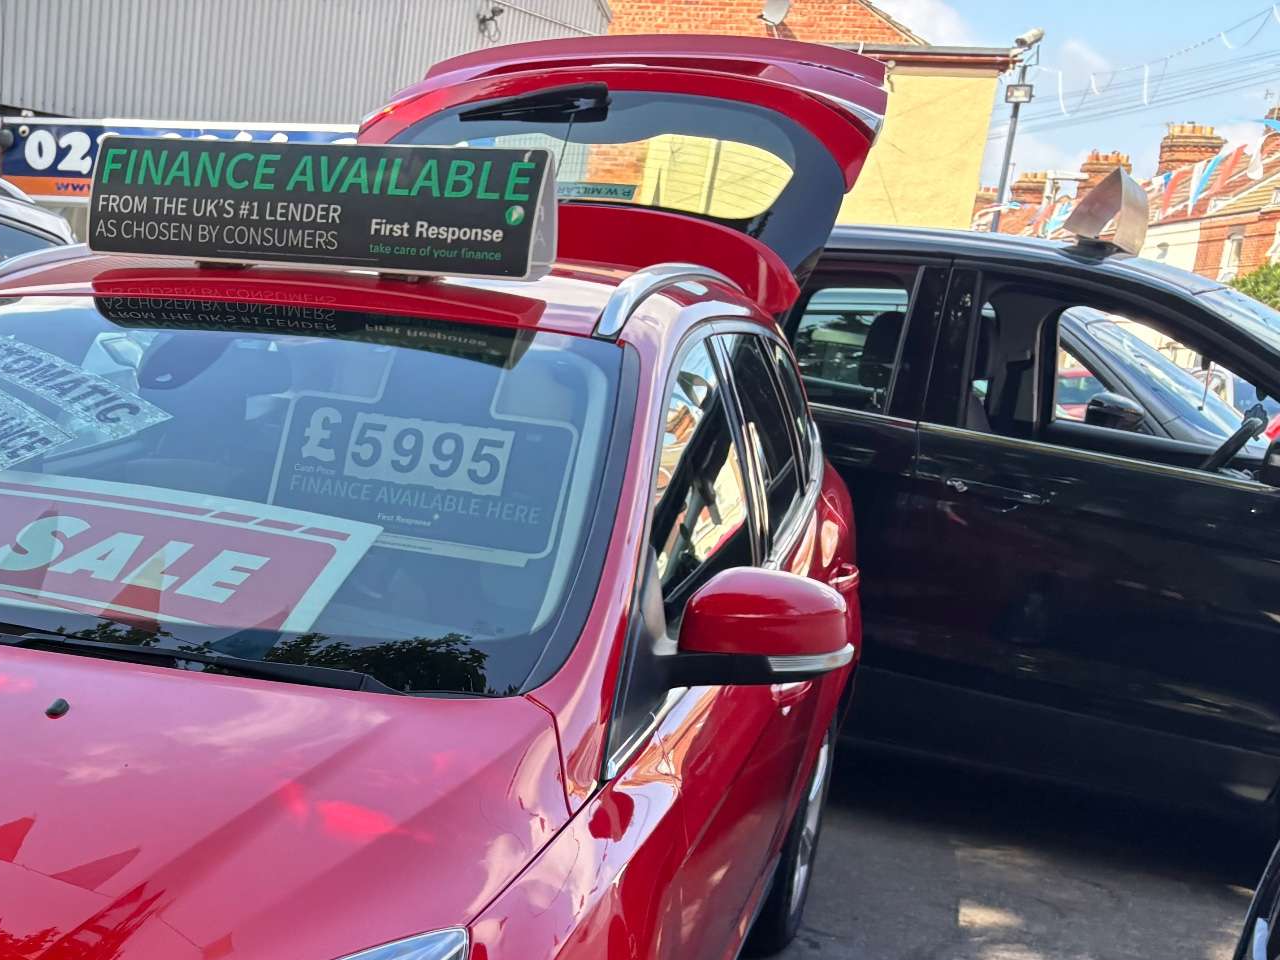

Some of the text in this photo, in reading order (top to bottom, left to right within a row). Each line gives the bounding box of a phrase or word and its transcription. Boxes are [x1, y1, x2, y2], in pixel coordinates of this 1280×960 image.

[24, 129, 98, 175] 02
[102, 148, 536, 201] FINANCE AVAILABLE
[98, 194, 342, 224] FROM THE UK'S #1 LENDER
[96, 219, 338, 250] AS CHOSEN BY CONSUMERS
[370, 218, 504, 243] First Response
[370, 243, 502, 262] take care of your finance
[300, 406, 505, 486] £5995
[289, 474, 541, 526] FINANCE AVAILABLE HERE
[376, 511, 432, 528] First Response
